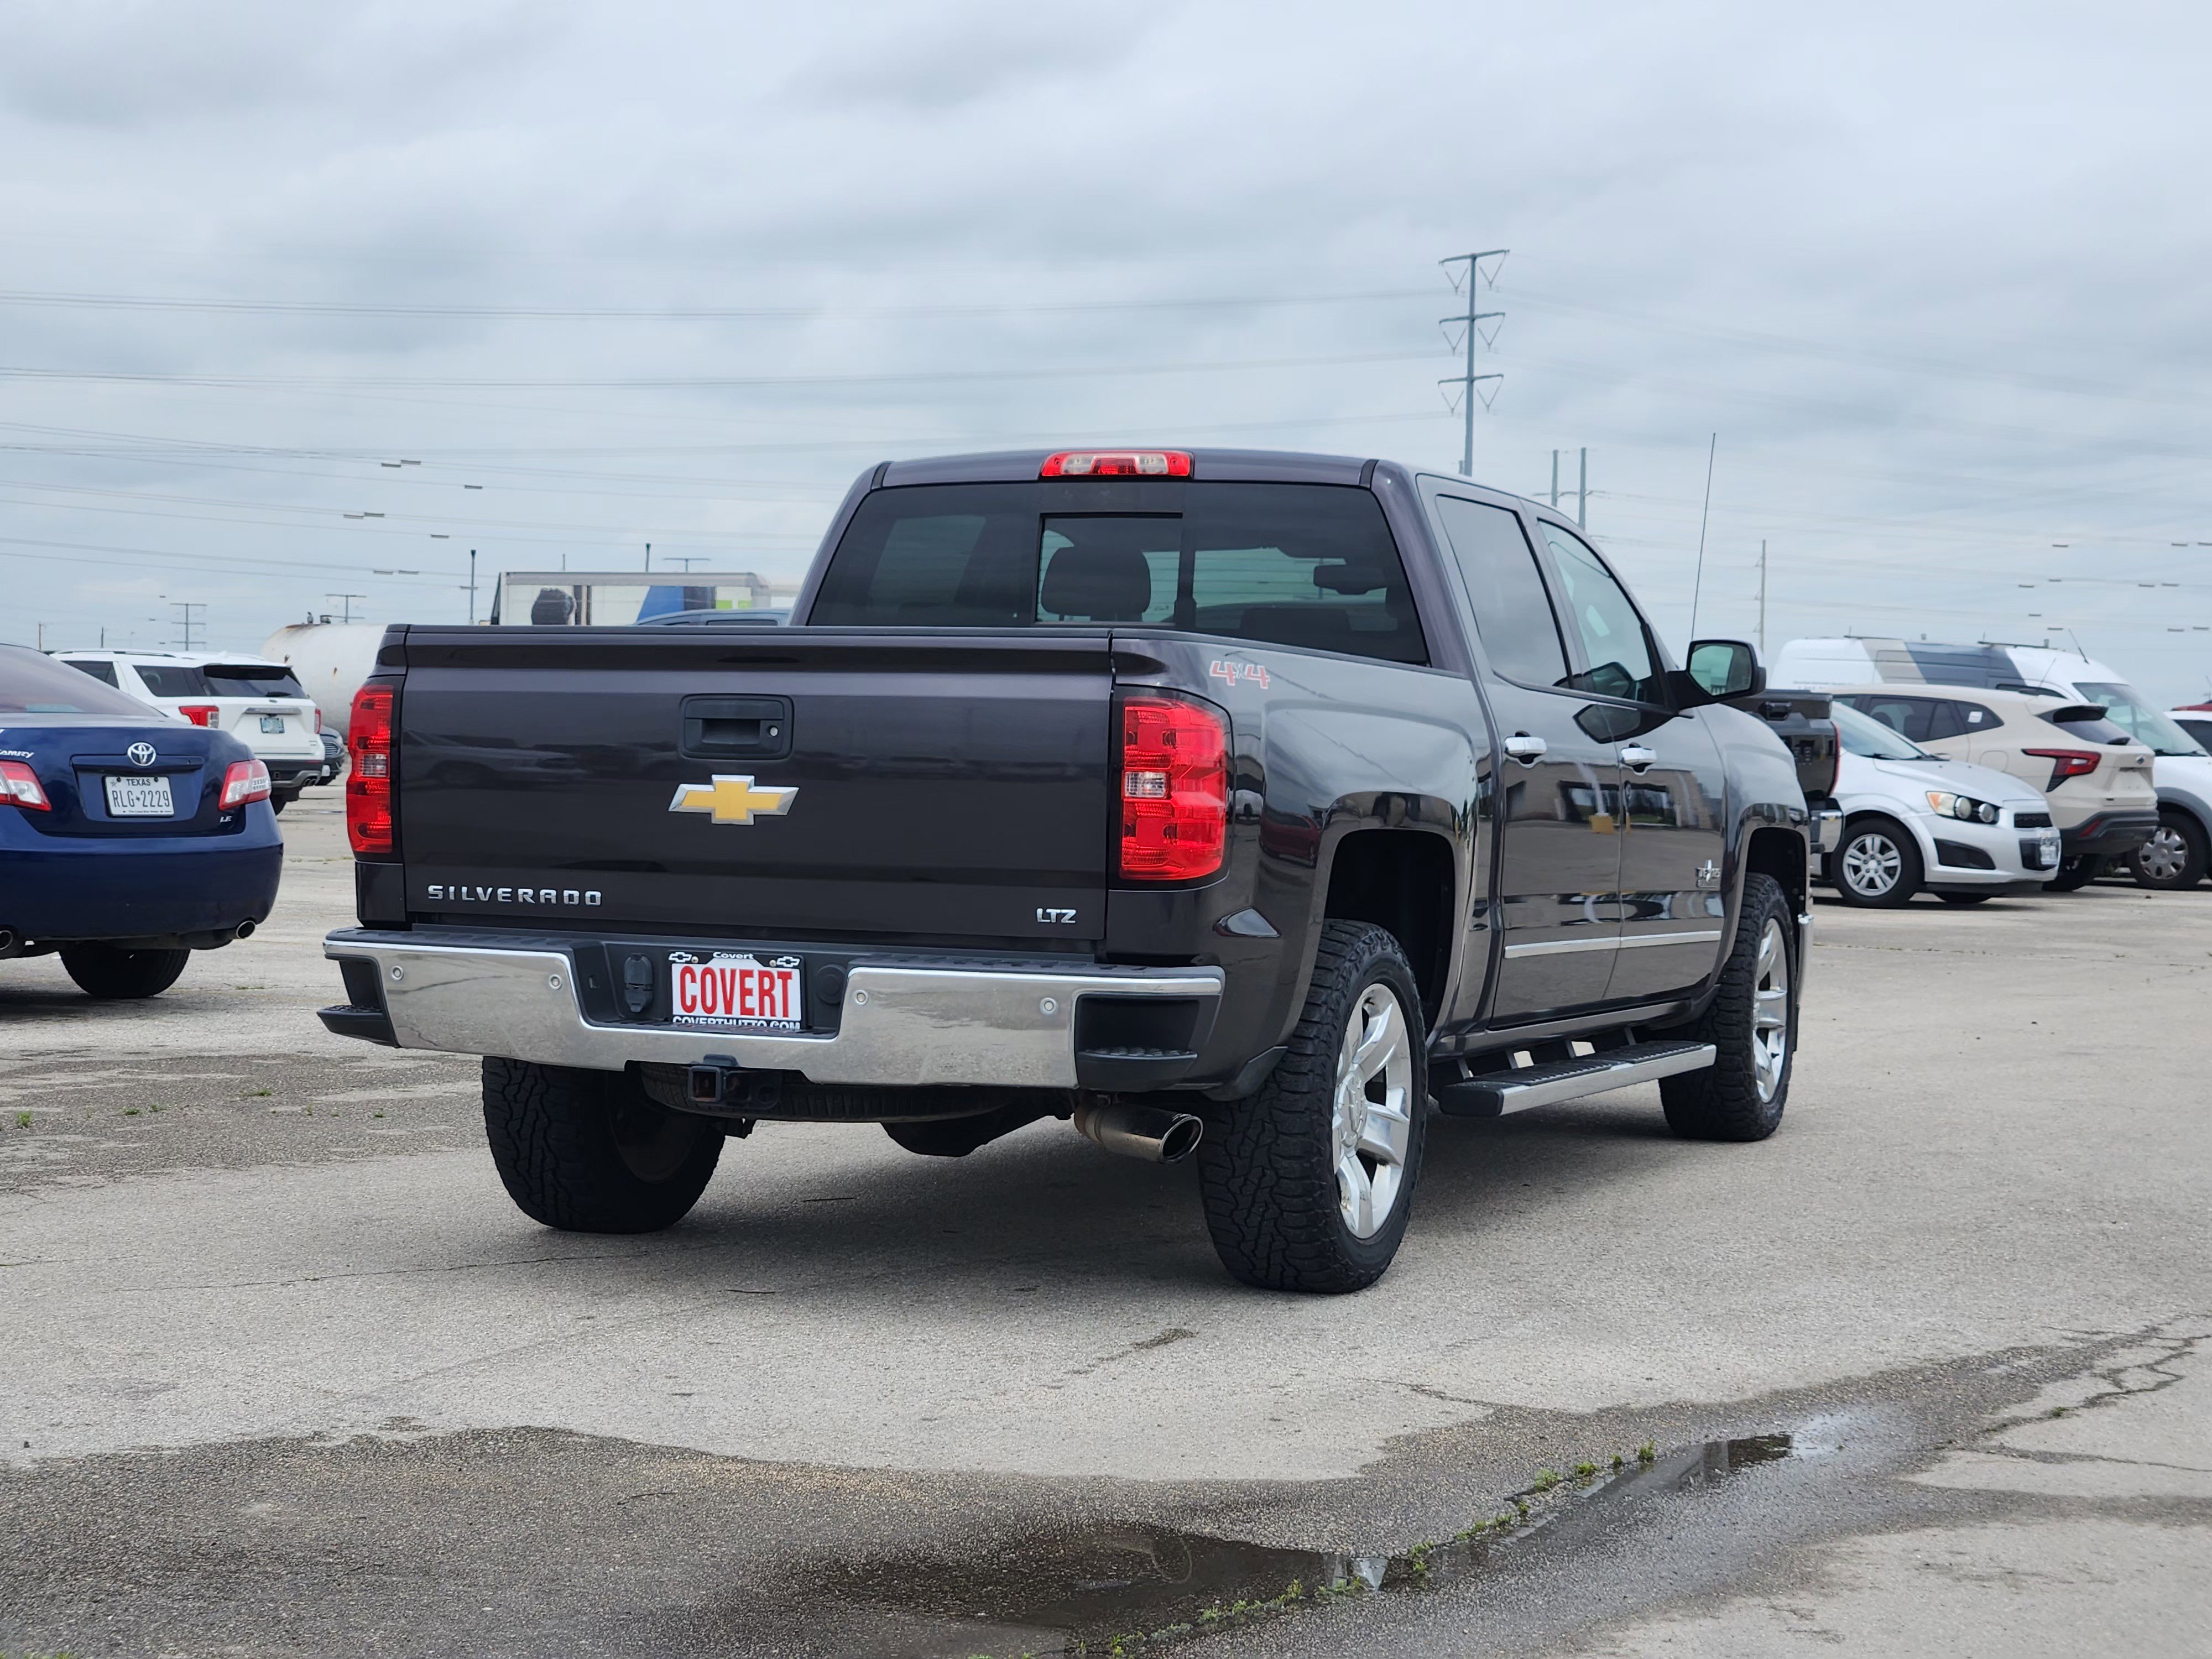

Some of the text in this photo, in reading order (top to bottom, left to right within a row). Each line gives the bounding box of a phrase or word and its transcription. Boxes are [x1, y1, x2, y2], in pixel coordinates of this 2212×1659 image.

[0, 749, 35, 758] AMRY
[427, 885, 602, 906] SILVERADO
[1036, 908, 1076, 924] LTZ
[680, 966, 792, 1018] COVERT
[672, 1016, 801, 1030] COVERTHUTTOCOM
